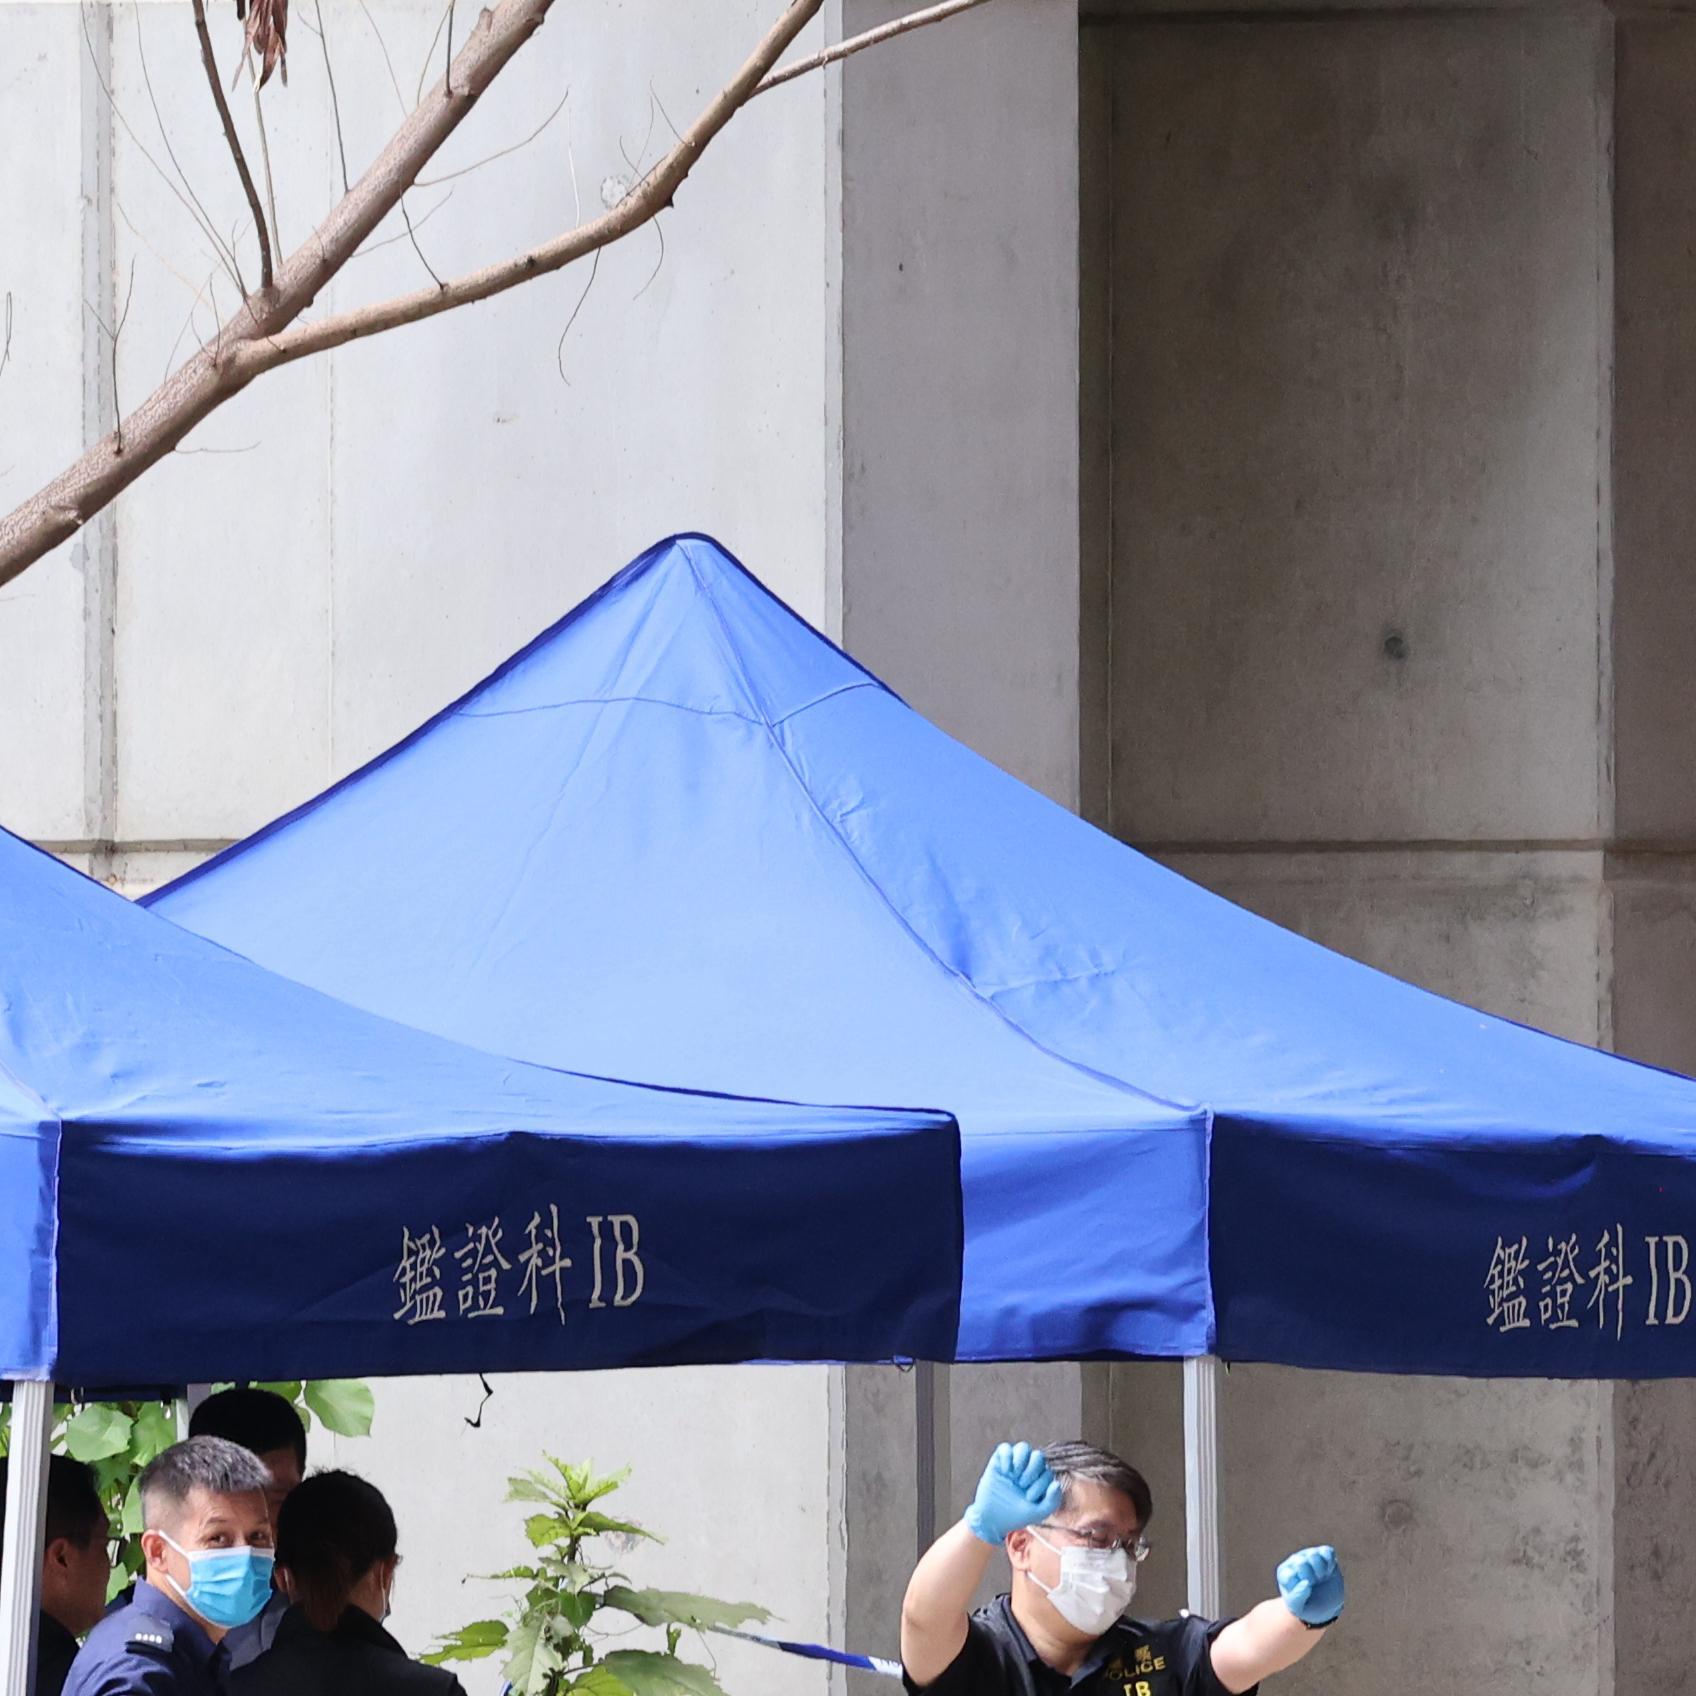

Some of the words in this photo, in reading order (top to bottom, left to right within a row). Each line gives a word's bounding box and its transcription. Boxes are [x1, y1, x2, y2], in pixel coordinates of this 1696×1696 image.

[393, 1203, 572, 1326] 鑑證科
[586, 1214, 644, 1309] IB
[1483, 1223, 1633, 1341] 鑑證科
[1644, 1235, 1692, 1326] IB
[1108, 1656, 1166, 1680] OLICE
